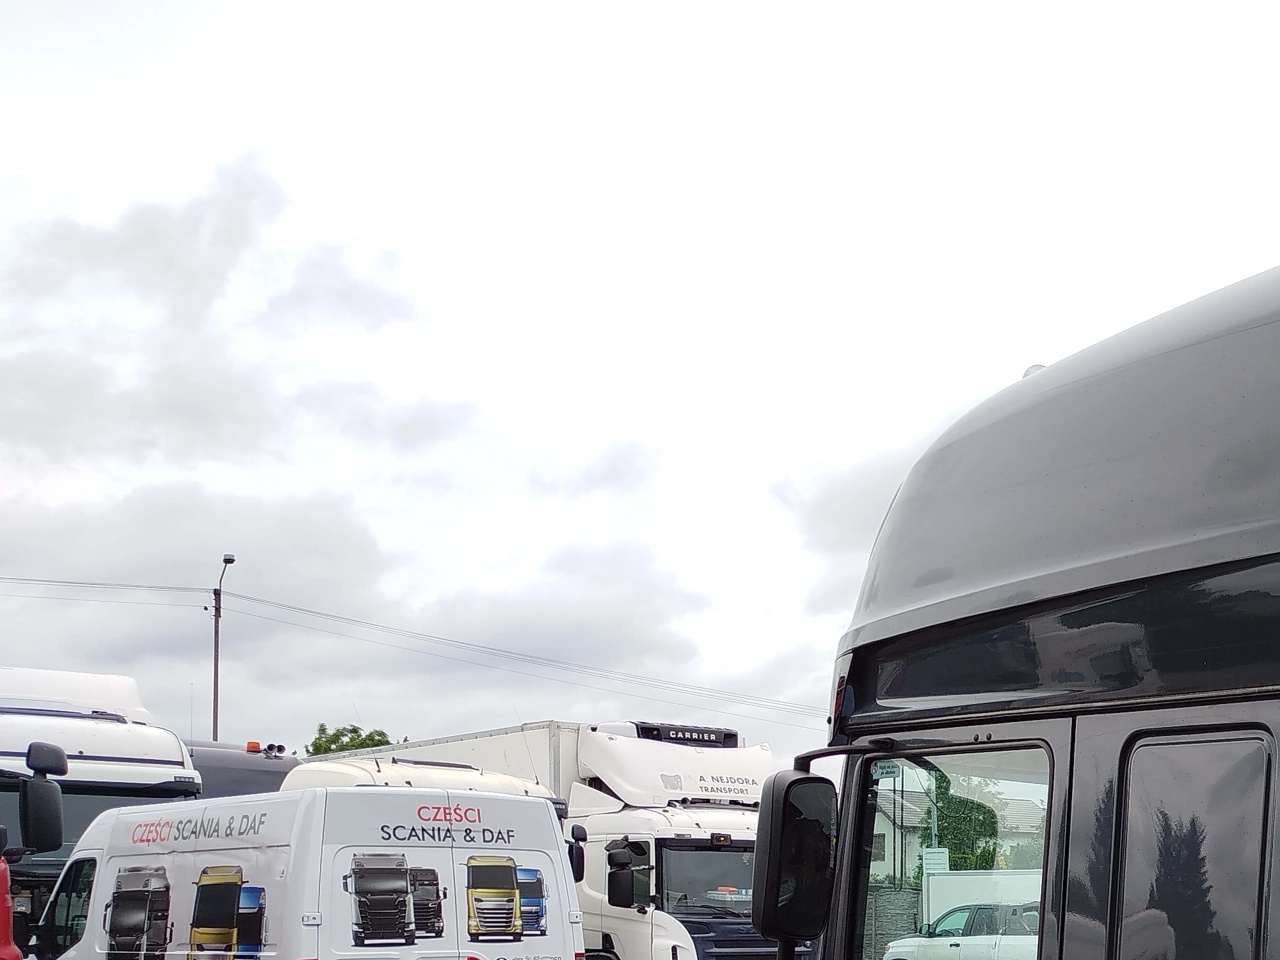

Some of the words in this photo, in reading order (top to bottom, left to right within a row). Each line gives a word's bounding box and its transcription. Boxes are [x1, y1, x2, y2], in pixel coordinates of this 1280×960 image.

[669, 730, 716, 740] CARRIER
[711, 776, 758, 786] NEJDORA
[699, 786, 749, 795] TRANSPORT
[417, 804, 482, 825] CZĘŚCI
[131, 817, 173, 847] CZĘŚCI
[173, 818, 220, 841] SCANIA
[224, 815, 235, 838] &
[237, 812, 267, 836] DAF
[380, 825, 456, 843] SCANIA
[463, 827, 477, 843] &
[482, 828, 515, 844] DAF
